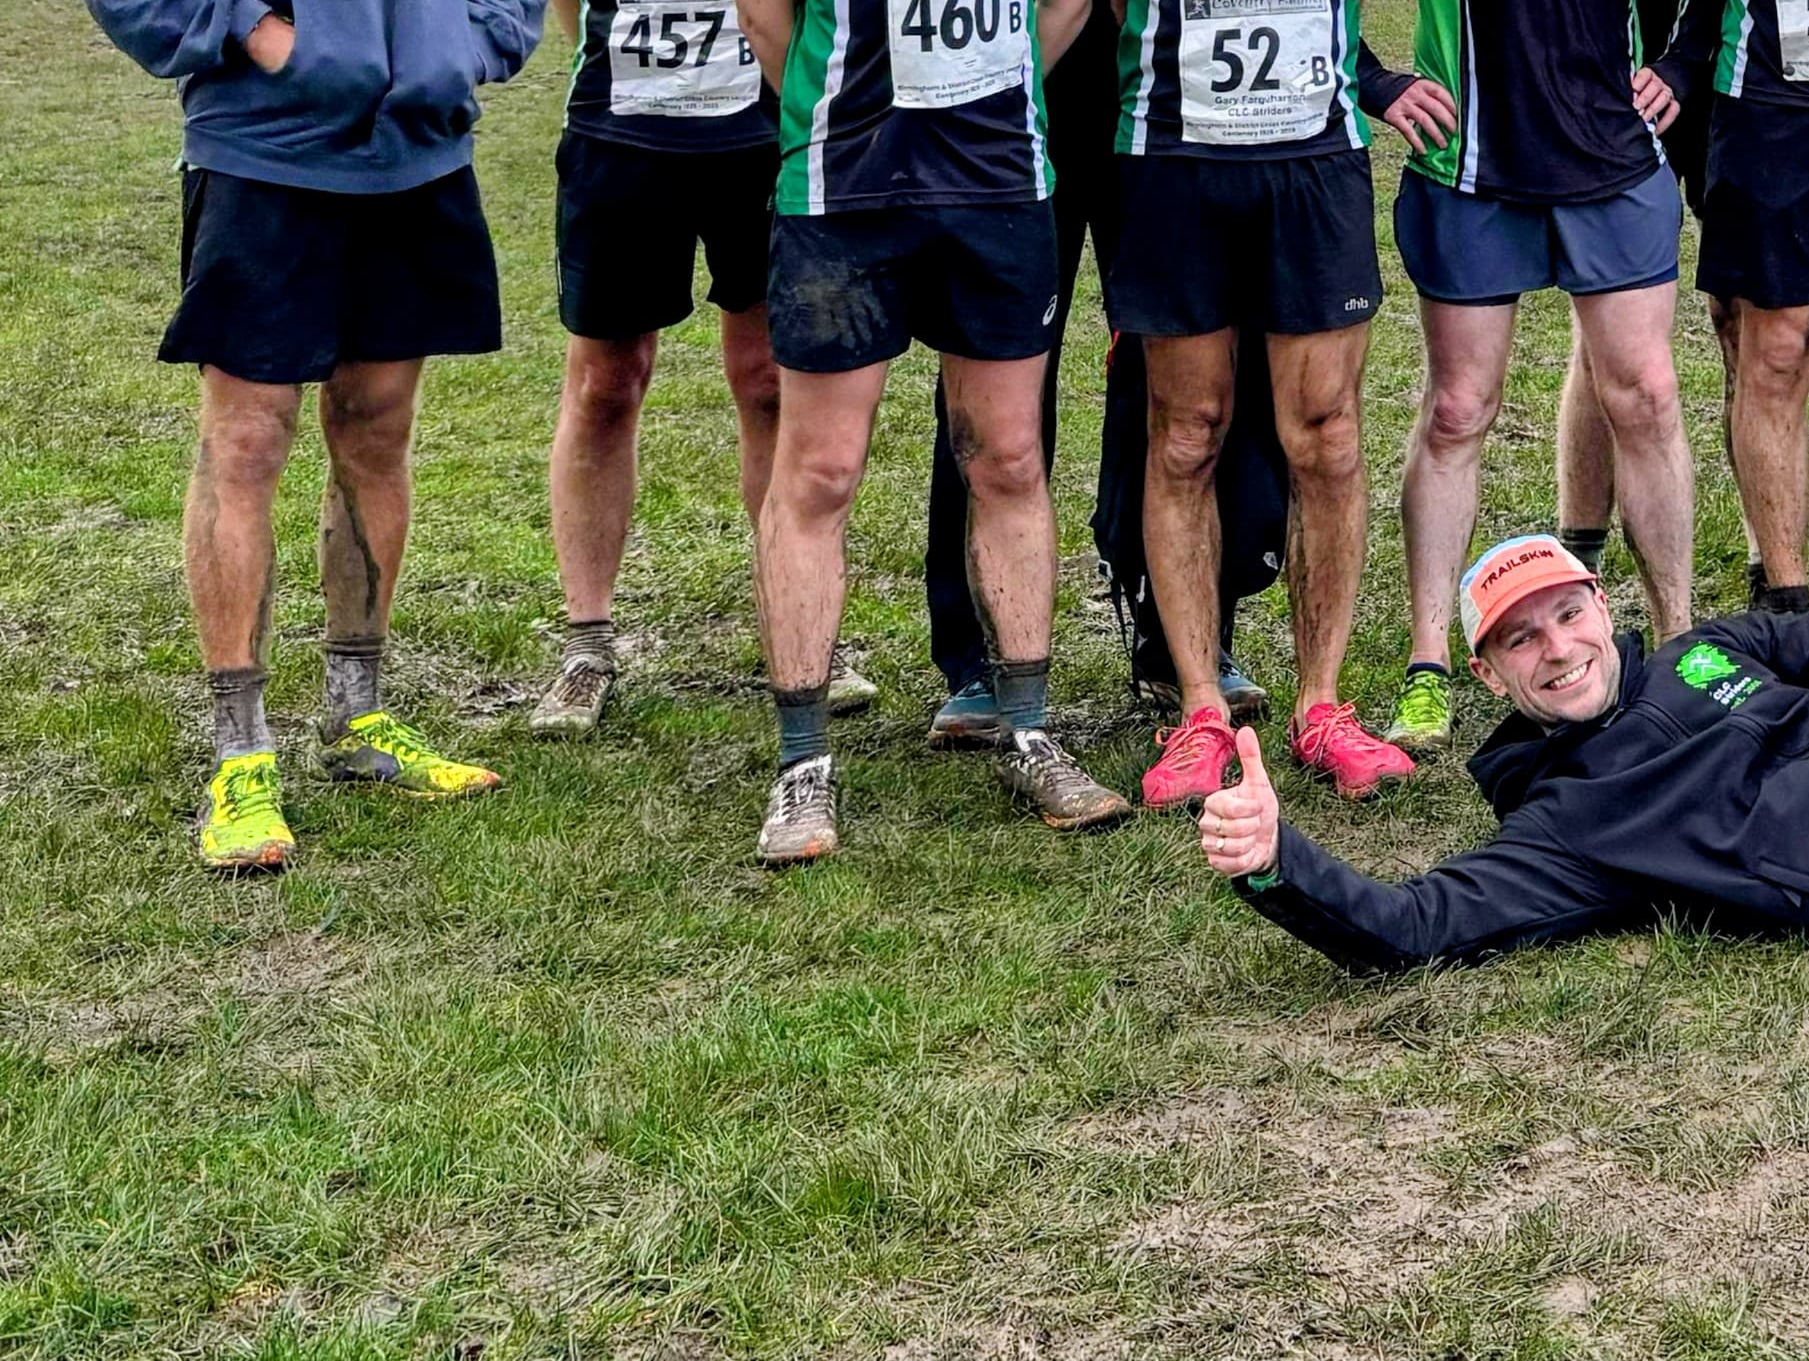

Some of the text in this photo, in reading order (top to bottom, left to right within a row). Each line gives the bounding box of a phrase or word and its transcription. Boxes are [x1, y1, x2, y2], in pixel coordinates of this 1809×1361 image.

[1009, 1, 1022, 34] B
[620, 10, 755, 69] 457 B
[1210, 26, 1330, 92] 52 B
[1344, 297, 1369, 311] dhb
[1480, 549, 1554, 591] TRAILSKIN
